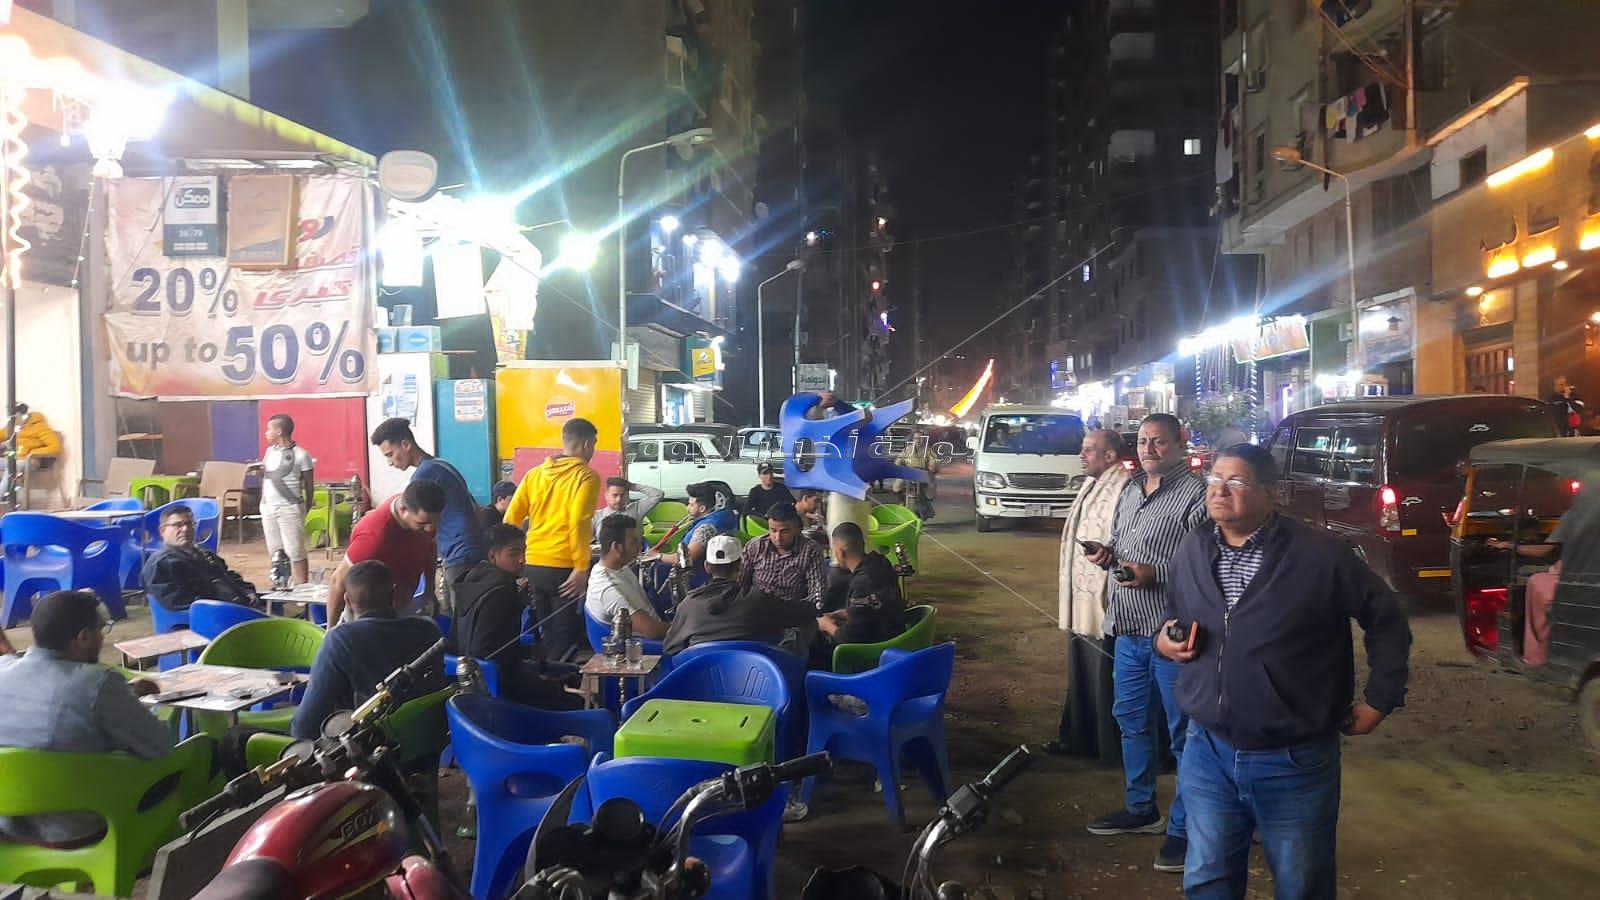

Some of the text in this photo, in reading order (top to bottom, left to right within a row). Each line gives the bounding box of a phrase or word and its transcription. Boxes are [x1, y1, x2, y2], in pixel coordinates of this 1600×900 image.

[175, 189, 210, 208] ممكن
[132, 267, 240, 317] 20%
[126, 339, 170, 370] up
[184, 335, 218, 364] to
[221, 320, 367, 387] 50%
